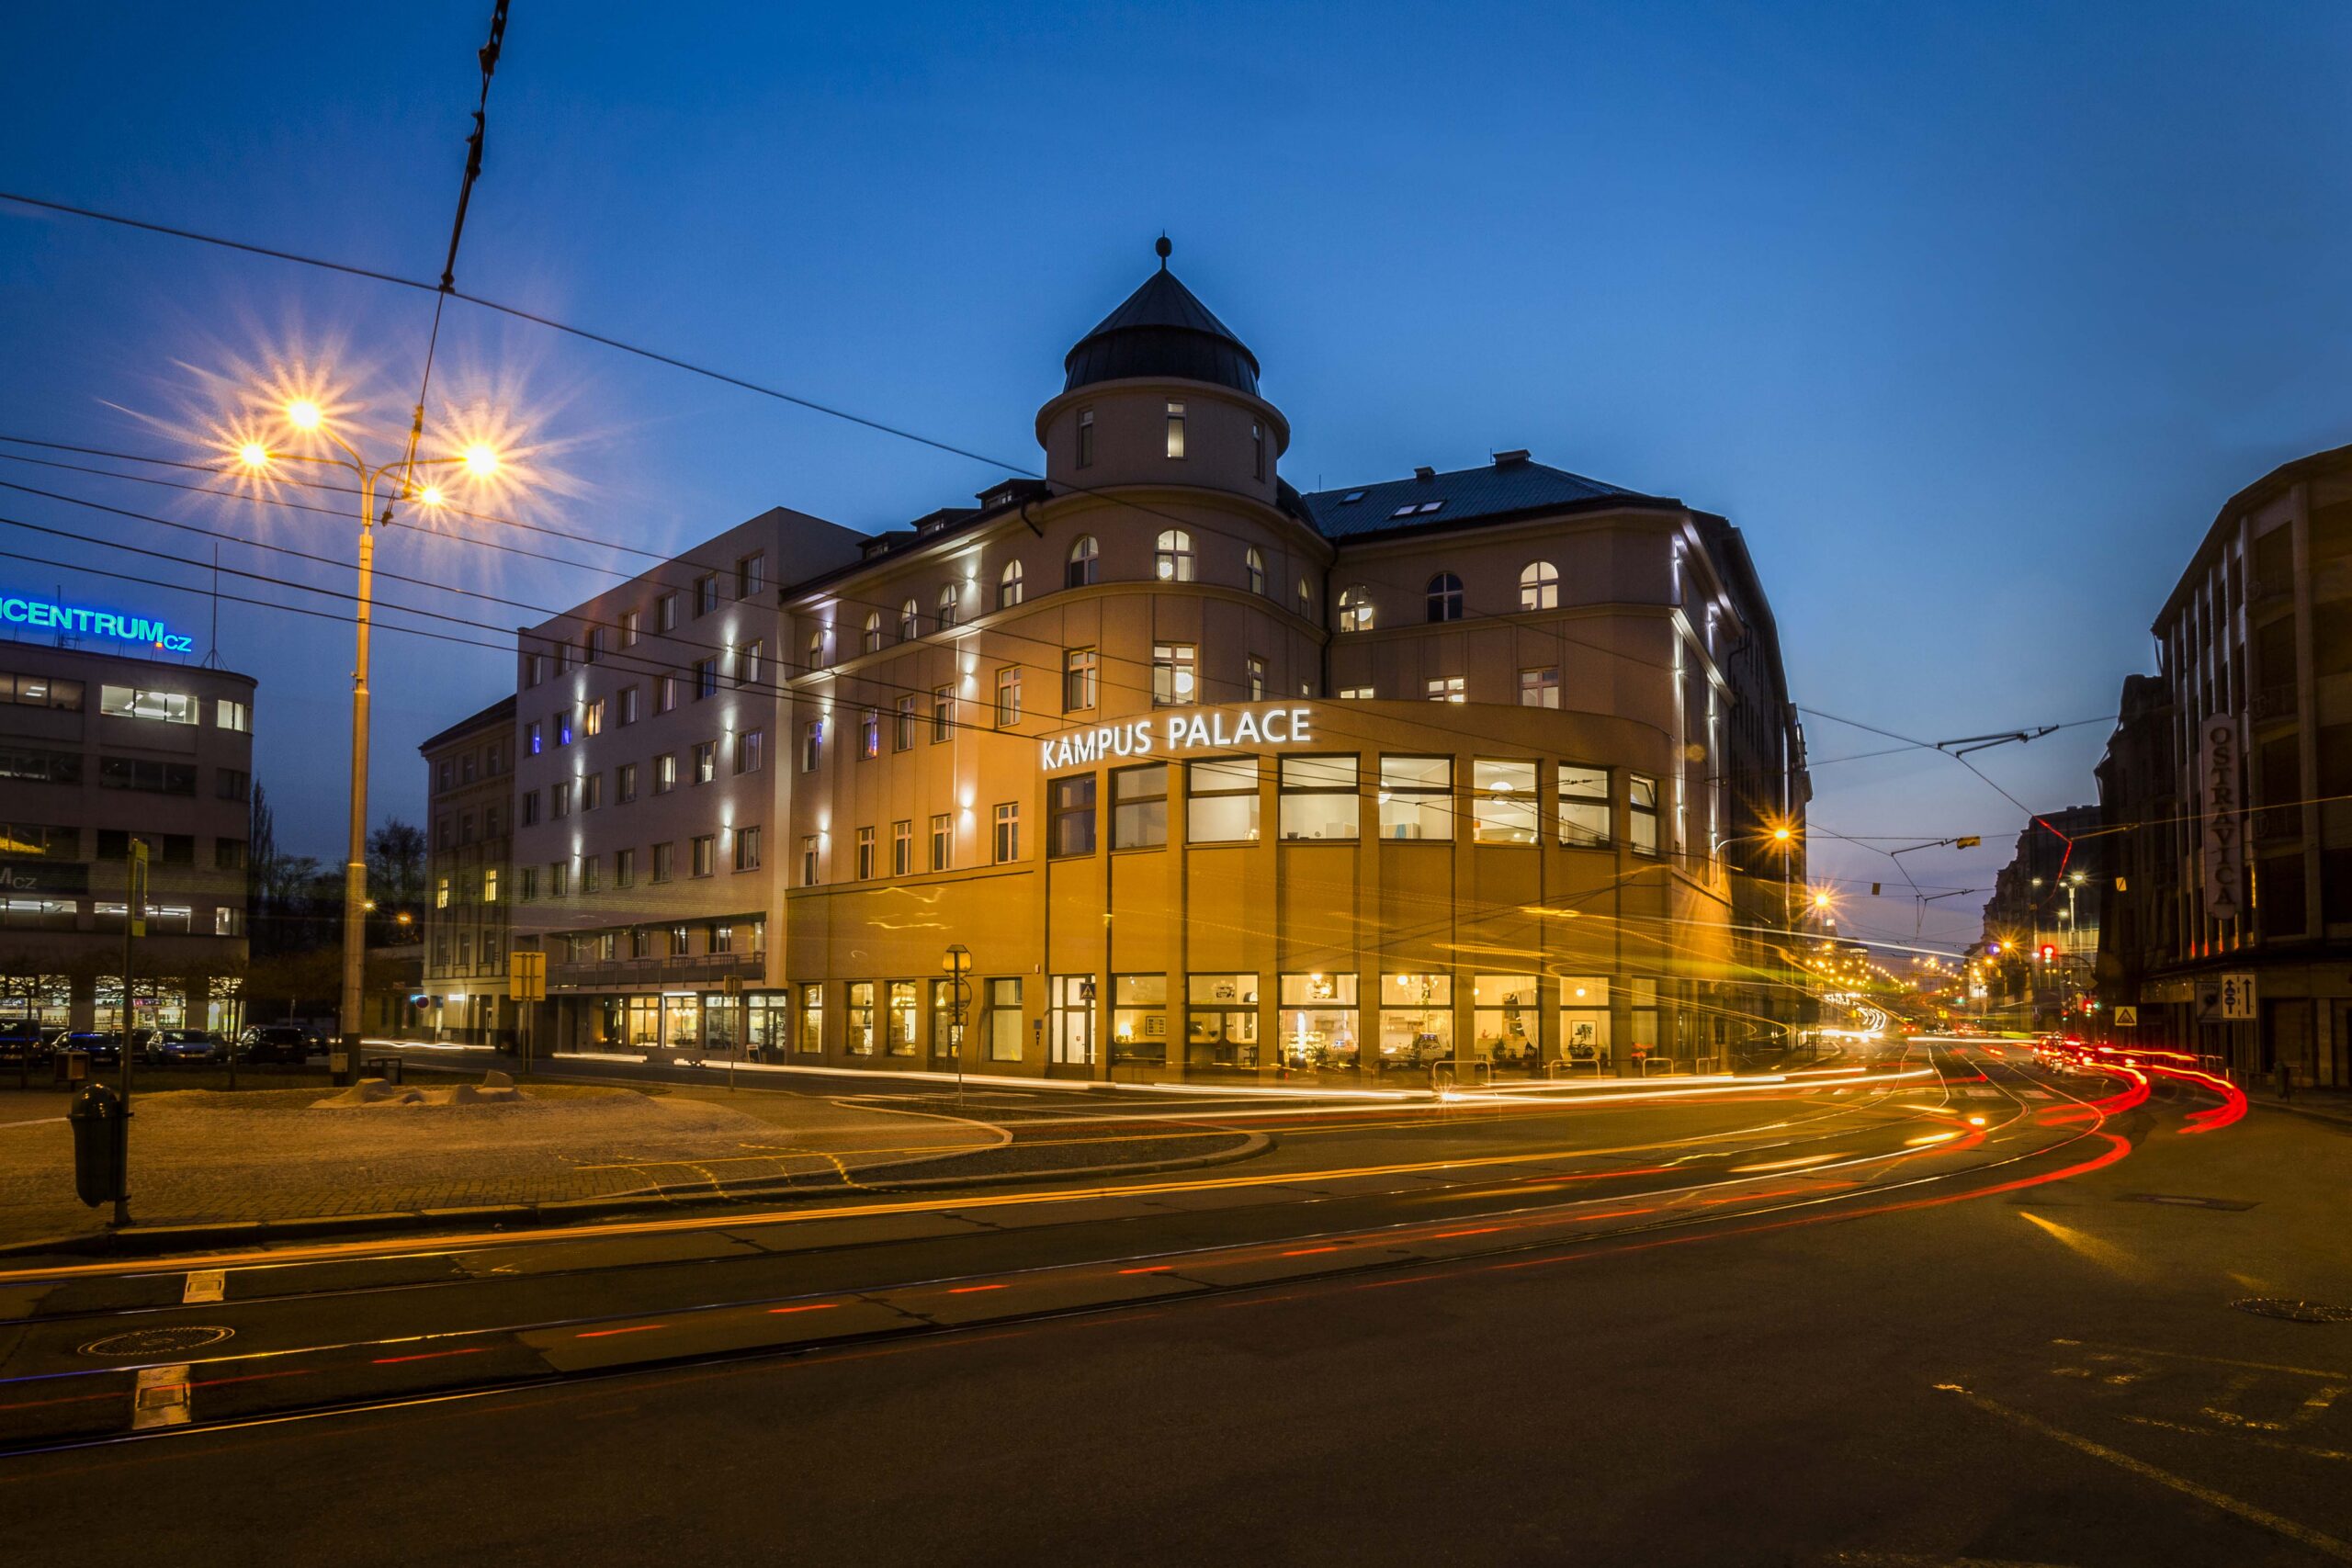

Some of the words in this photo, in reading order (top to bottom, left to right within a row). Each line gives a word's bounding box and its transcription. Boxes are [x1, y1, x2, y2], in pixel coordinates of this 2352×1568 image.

[1042, 721, 1152, 770] KAMPUS
[1169, 709, 1311, 750] PALACE
[2210, 727, 2236, 905] OSTRAVICA
